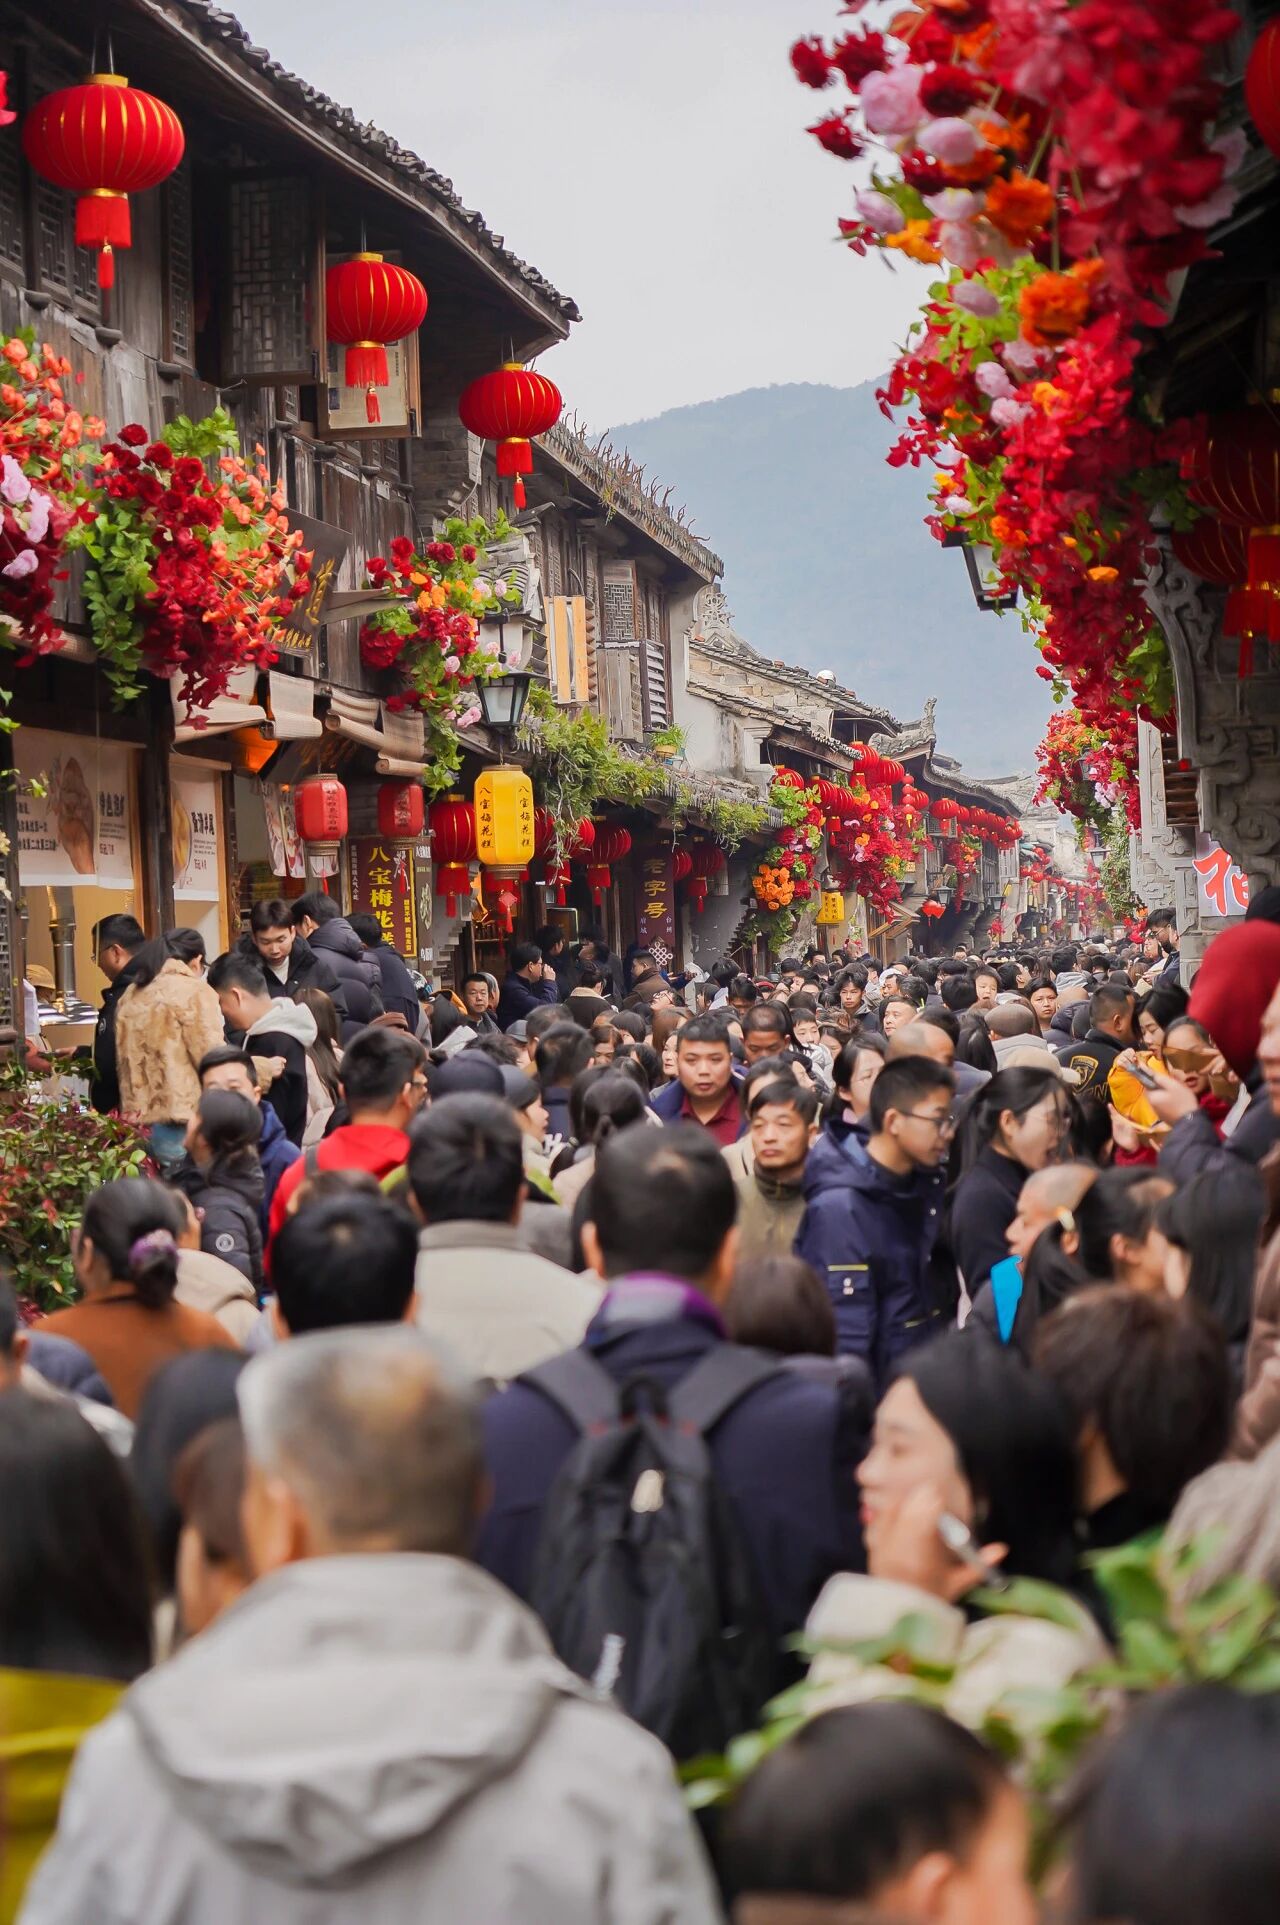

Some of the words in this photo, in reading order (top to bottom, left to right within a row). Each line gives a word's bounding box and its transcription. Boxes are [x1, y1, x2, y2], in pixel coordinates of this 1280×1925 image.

[480, 786, 493, 848] 八宝梅花糕
[643, 859, 668, 919] 老字号
